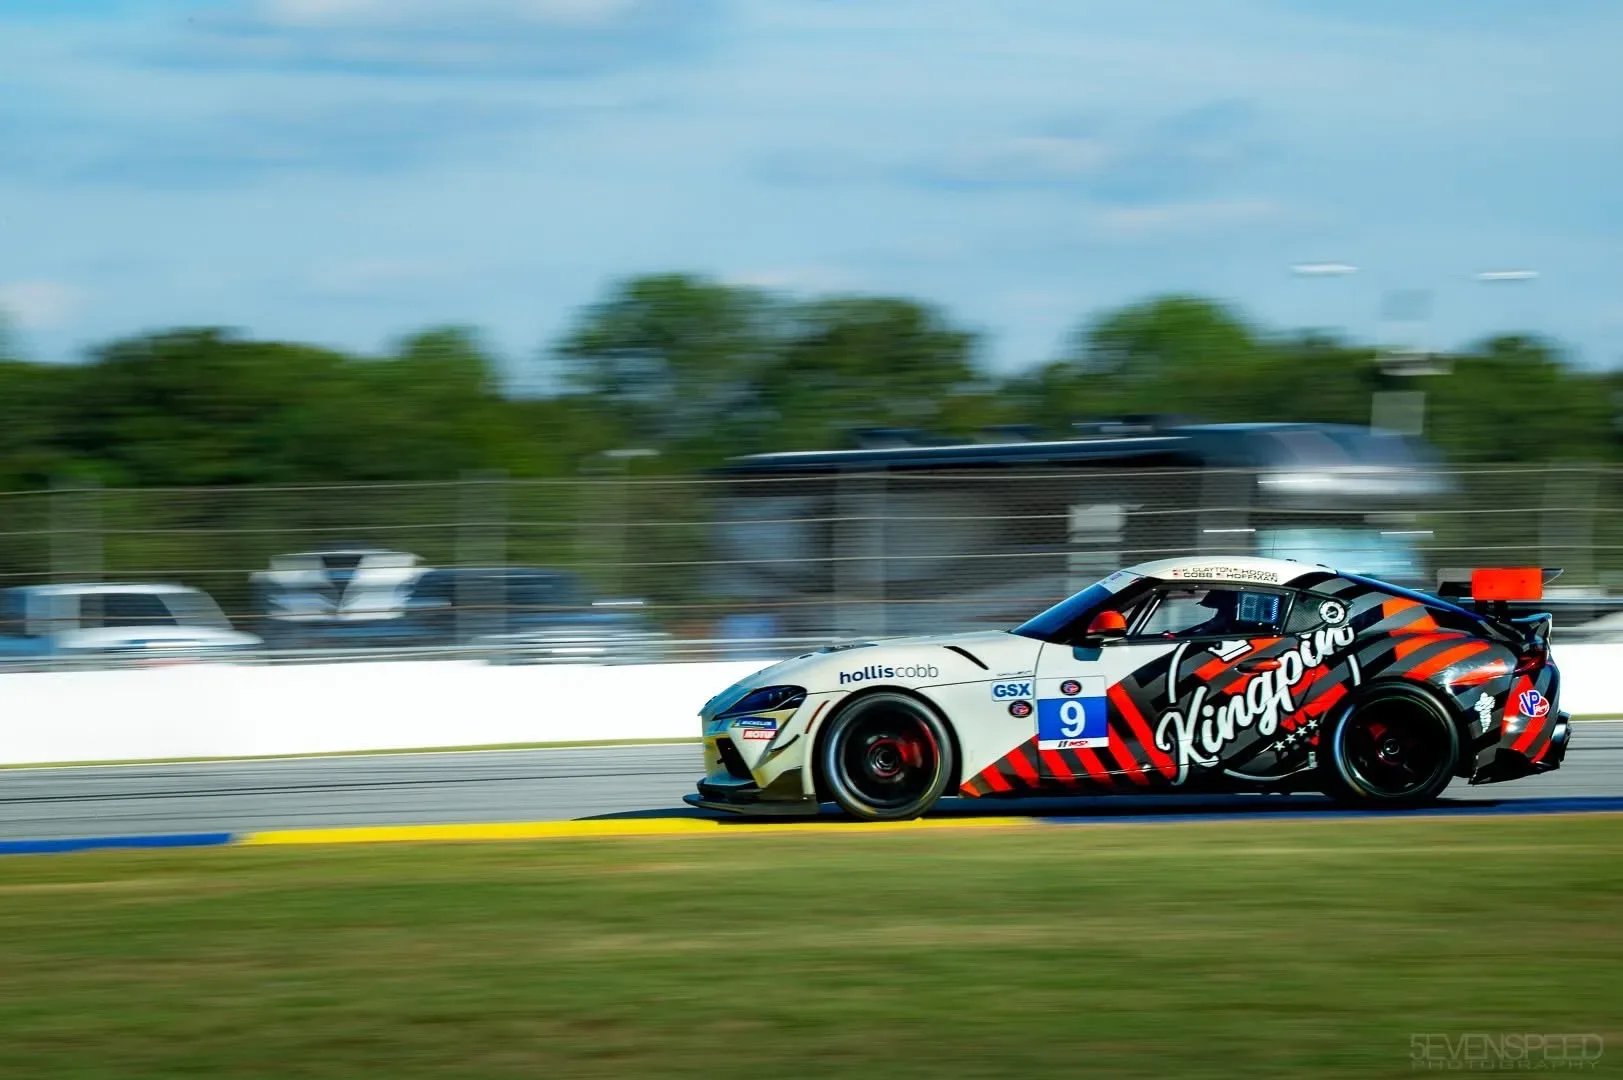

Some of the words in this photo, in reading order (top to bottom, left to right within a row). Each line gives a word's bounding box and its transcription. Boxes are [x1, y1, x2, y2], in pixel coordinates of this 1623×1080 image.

[1226, 573, 1278, 582] HOFFMAN
[1241, 568, 1278, 577] HODGE
[839, 663, 939, 685] holliscobb
[993, 683, 1031, 698] GSX
[1155, 626, 1355, 786] Kingpin
[1520, 690, 1541, 716] VP
[1059, 700, 1086, 738] 9
